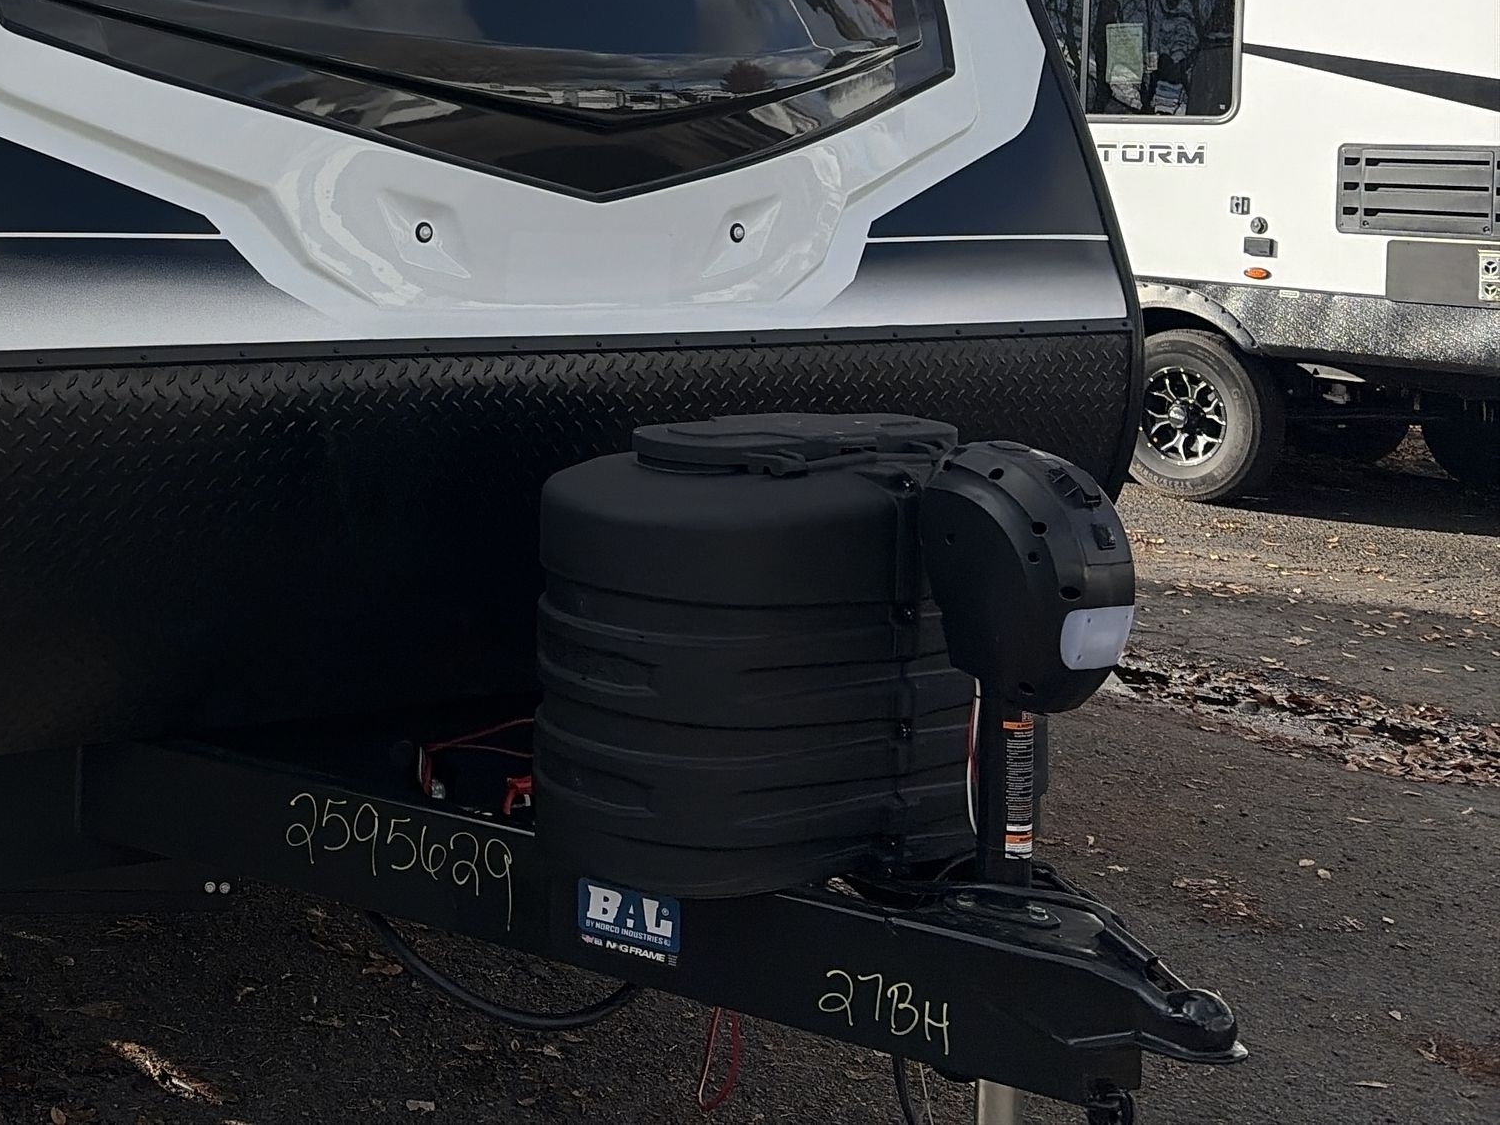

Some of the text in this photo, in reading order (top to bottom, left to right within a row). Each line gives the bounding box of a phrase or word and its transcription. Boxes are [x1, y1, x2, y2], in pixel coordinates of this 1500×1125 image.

[1096, 143, 1205, 165] TORM
[286, 793, 513, 932] 2595629
[585, 919, 664, 945] BY NORCO INDUSTRIES
[586, 884, 673, 938] BAL
[818, 969, 950, 1056] 27BH
